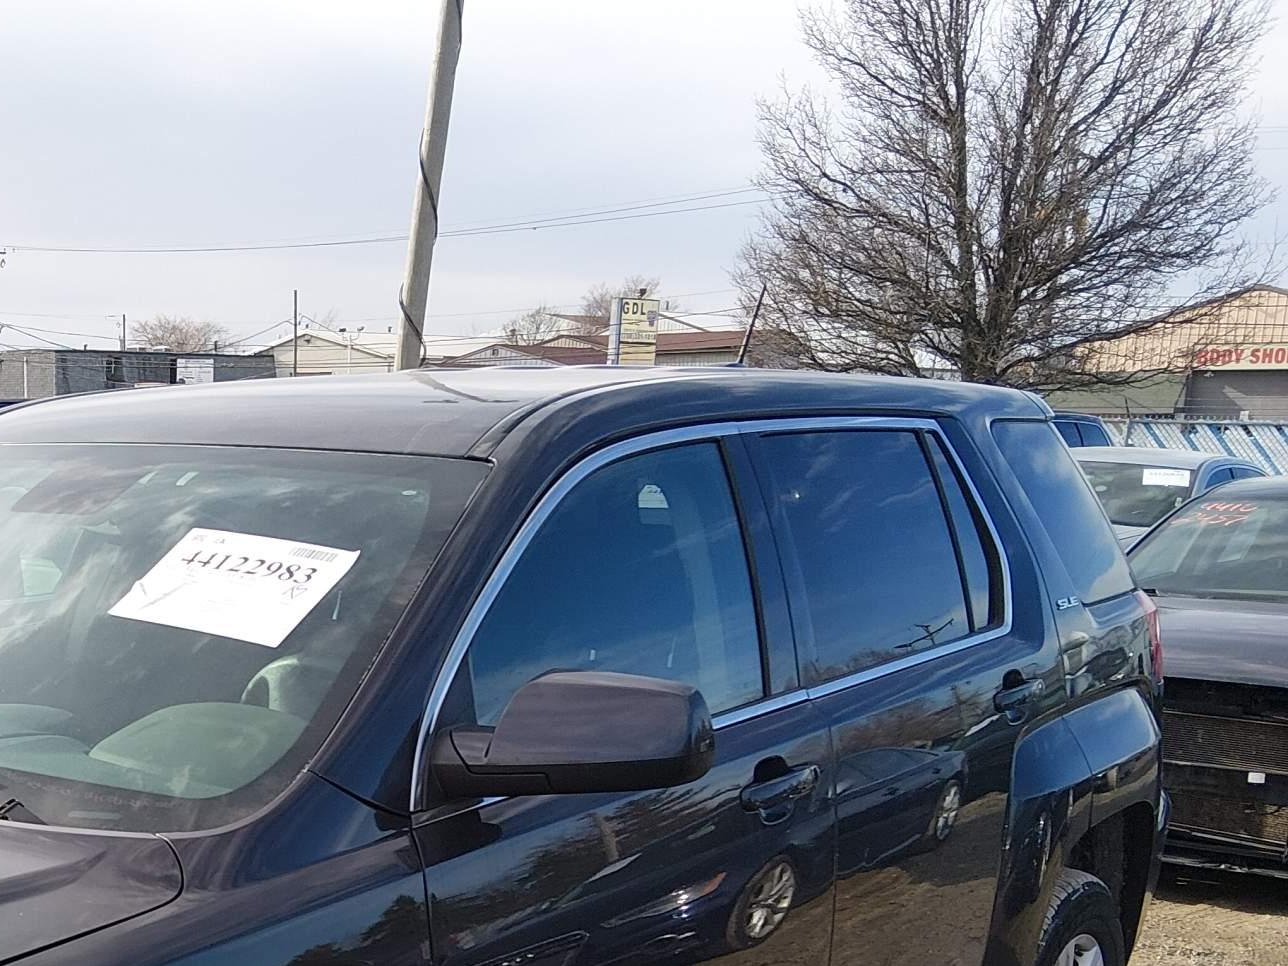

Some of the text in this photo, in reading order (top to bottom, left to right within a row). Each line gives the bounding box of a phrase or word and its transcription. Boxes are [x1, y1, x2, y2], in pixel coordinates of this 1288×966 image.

[622, 301, 646, 315] GDL
[1196, 347, 1288, 365] BODY SHO
[181, 550, 318, 584] 44122983
[1056, 595, 1080, 610] SLE
